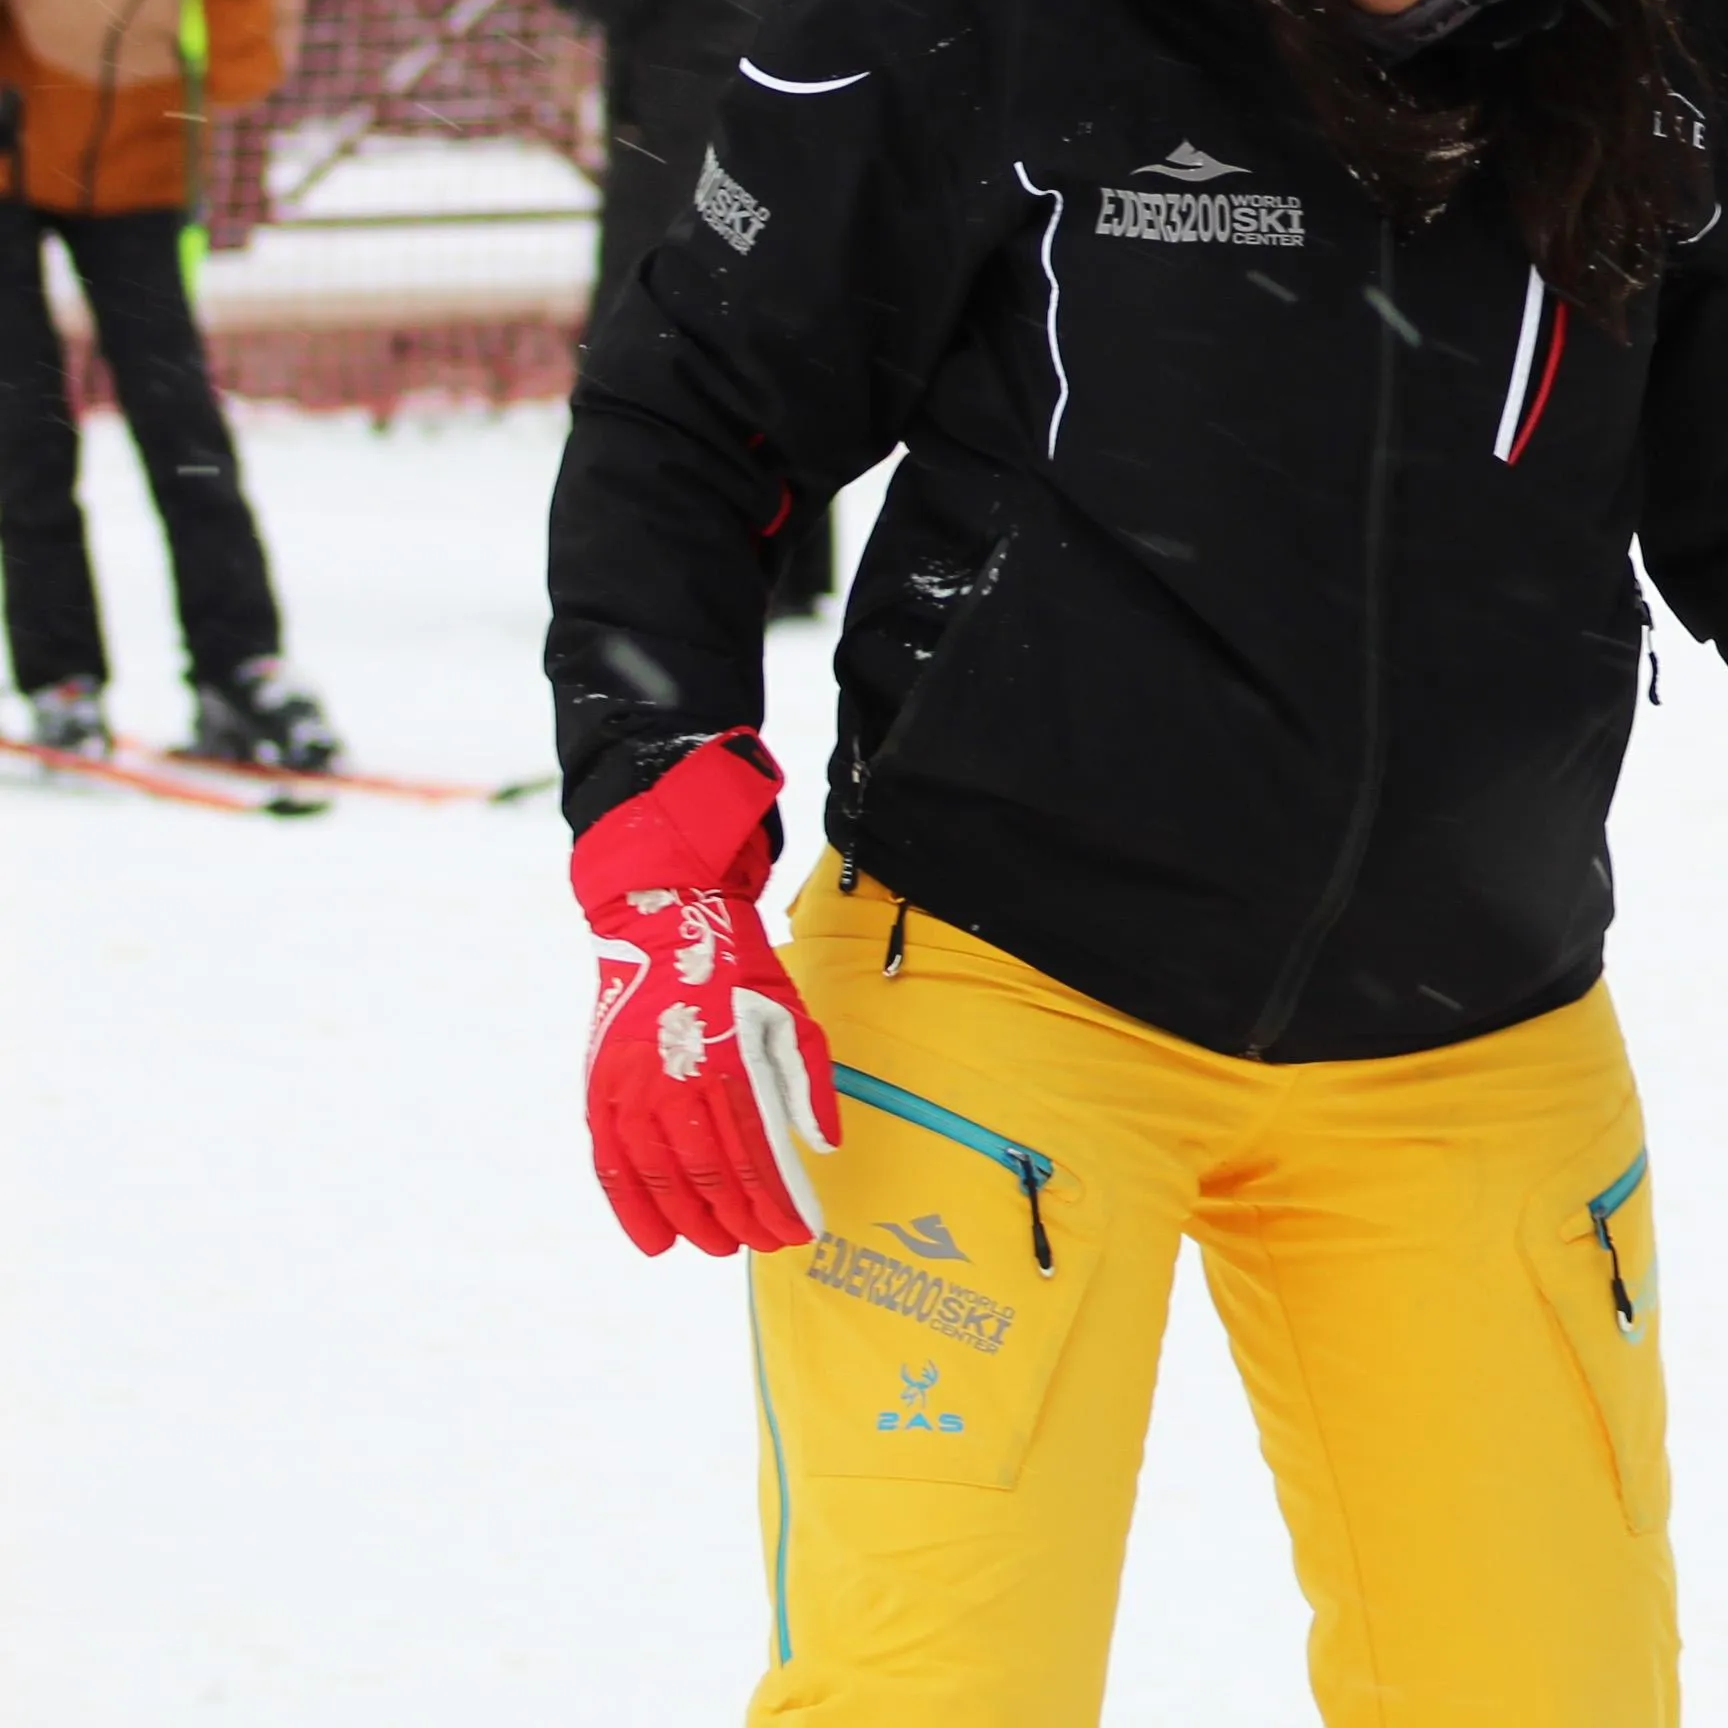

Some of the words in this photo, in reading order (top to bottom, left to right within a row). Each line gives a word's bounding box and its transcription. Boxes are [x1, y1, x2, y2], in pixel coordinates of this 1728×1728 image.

[1095, 187, 1231, 243] EJDER3200
[1229, 193, 1302, 209] WORLD
[1232, 207, 1305, 235] SKI
[1231, 232, 1305, 247] CENTER
[937, 1295, 1012, 1346] SKI
